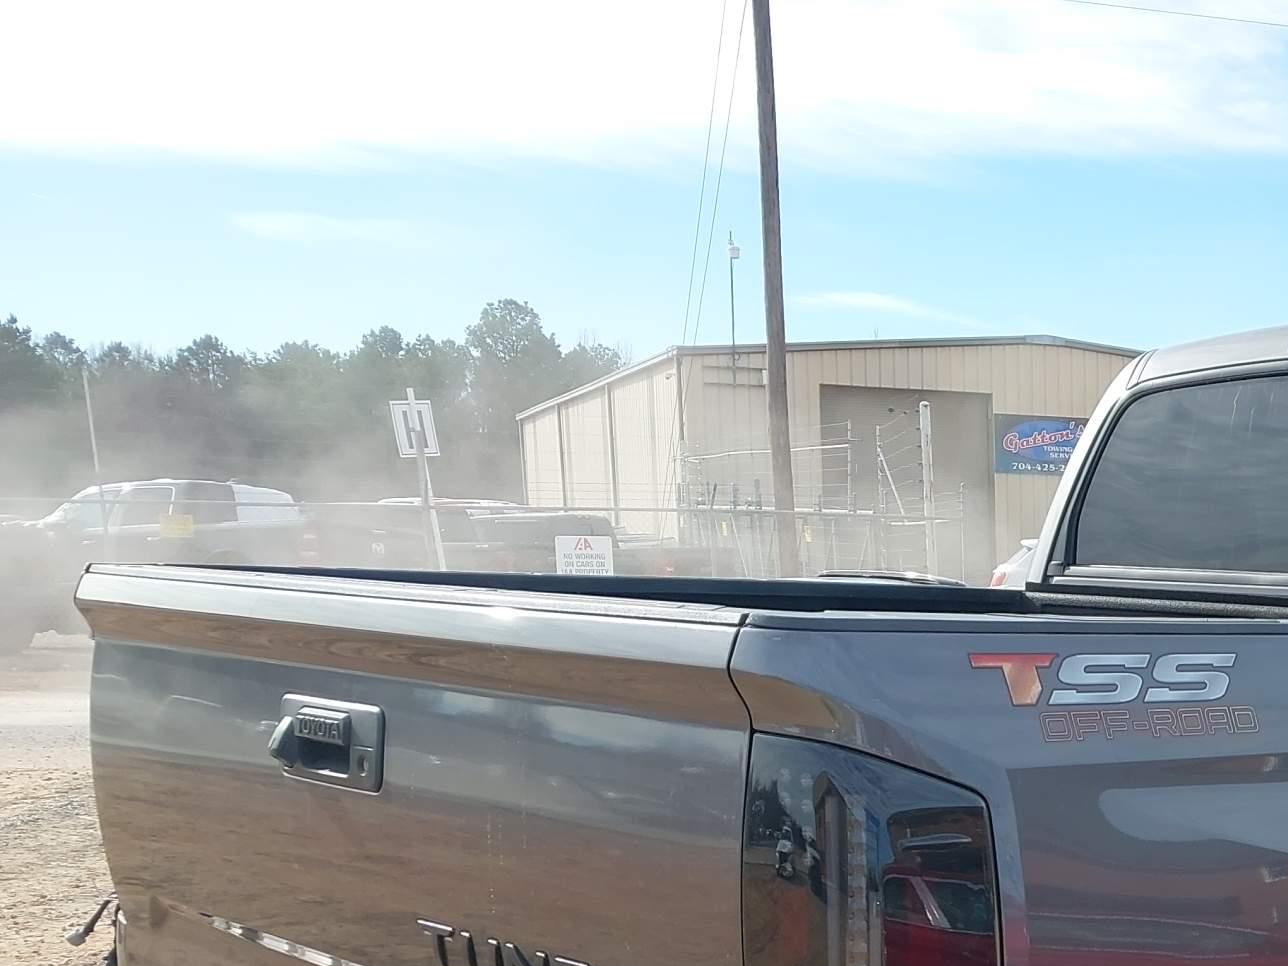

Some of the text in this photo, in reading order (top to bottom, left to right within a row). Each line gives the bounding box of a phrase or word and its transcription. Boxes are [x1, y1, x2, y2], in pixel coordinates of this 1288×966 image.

[1011, 462, 1066, 472] 704-425-2
[967, 652, 1238, 707] TSS
[1040, 705, 1260, 743] OFF-ROAD
